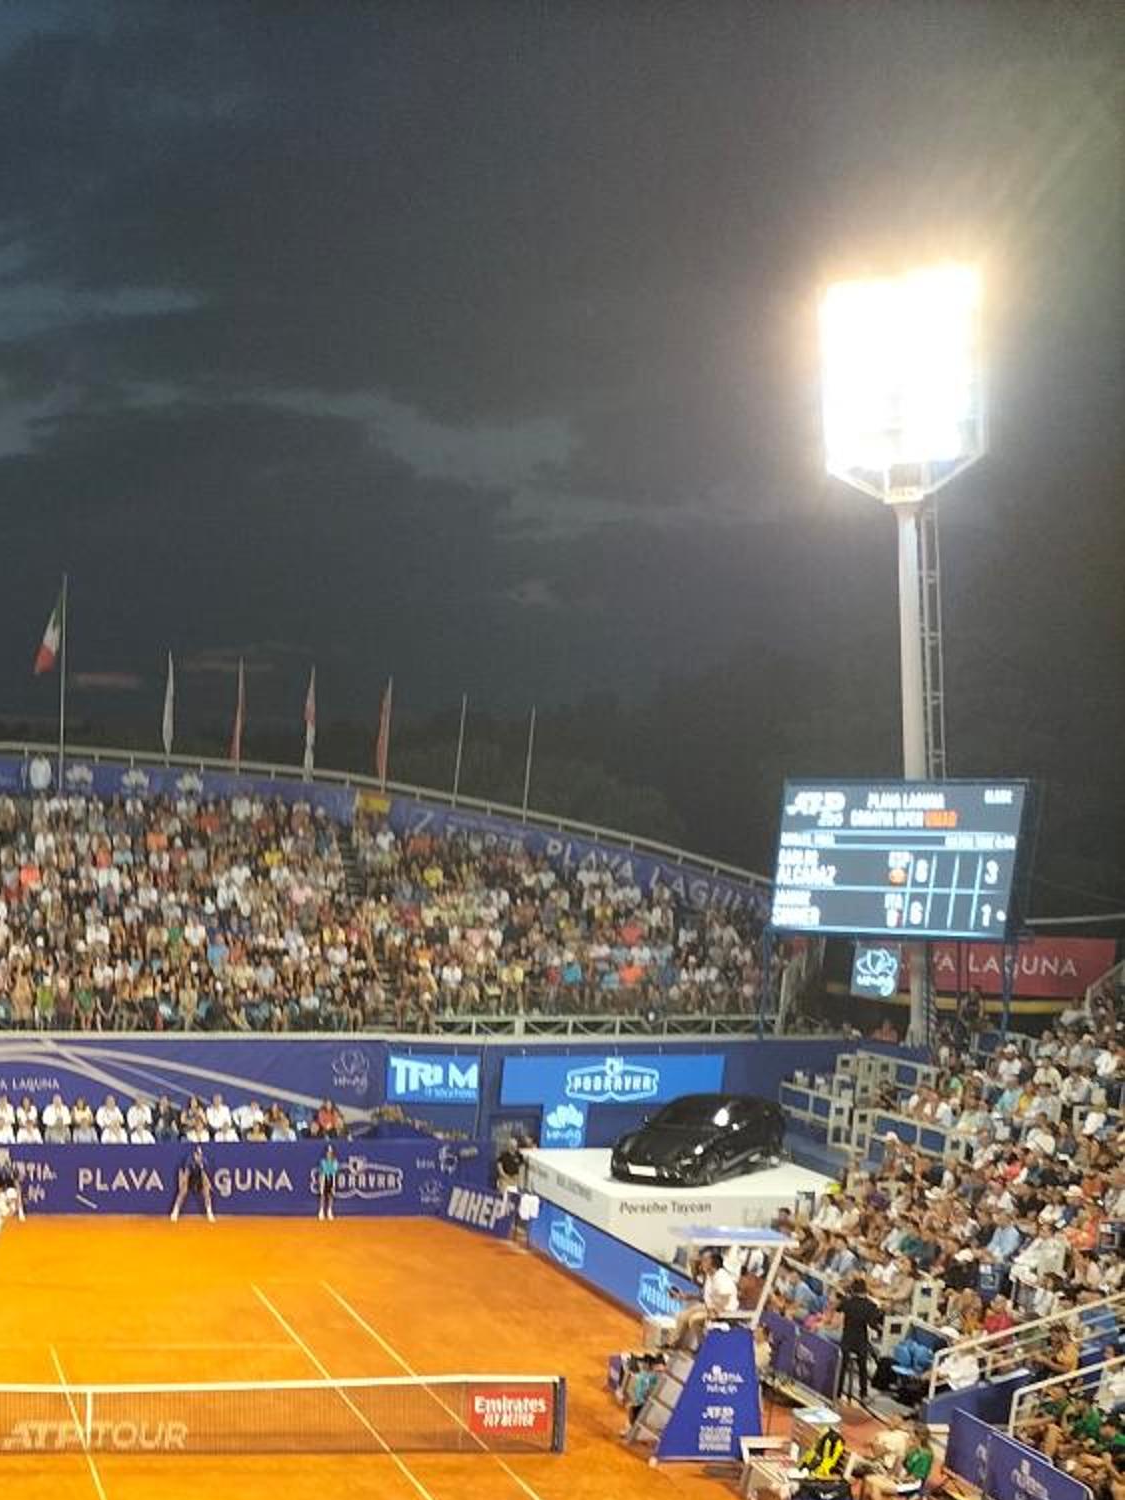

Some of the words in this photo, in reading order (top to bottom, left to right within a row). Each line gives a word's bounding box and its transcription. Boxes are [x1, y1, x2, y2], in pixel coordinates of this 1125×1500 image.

[984, 859, 1000, 885] 3
[909, 901, 923, 926] 6
[982, 903, 992, 928] 1
[78, 1167, 164, 1192] PLAVA
[618, 1201, 668, 1217] Porsche
[672, 1200, 713, 1216] Taycan
[474, 1394, 547, 1414] Emirates
[89, 1420, 188, 1449] TOUR
